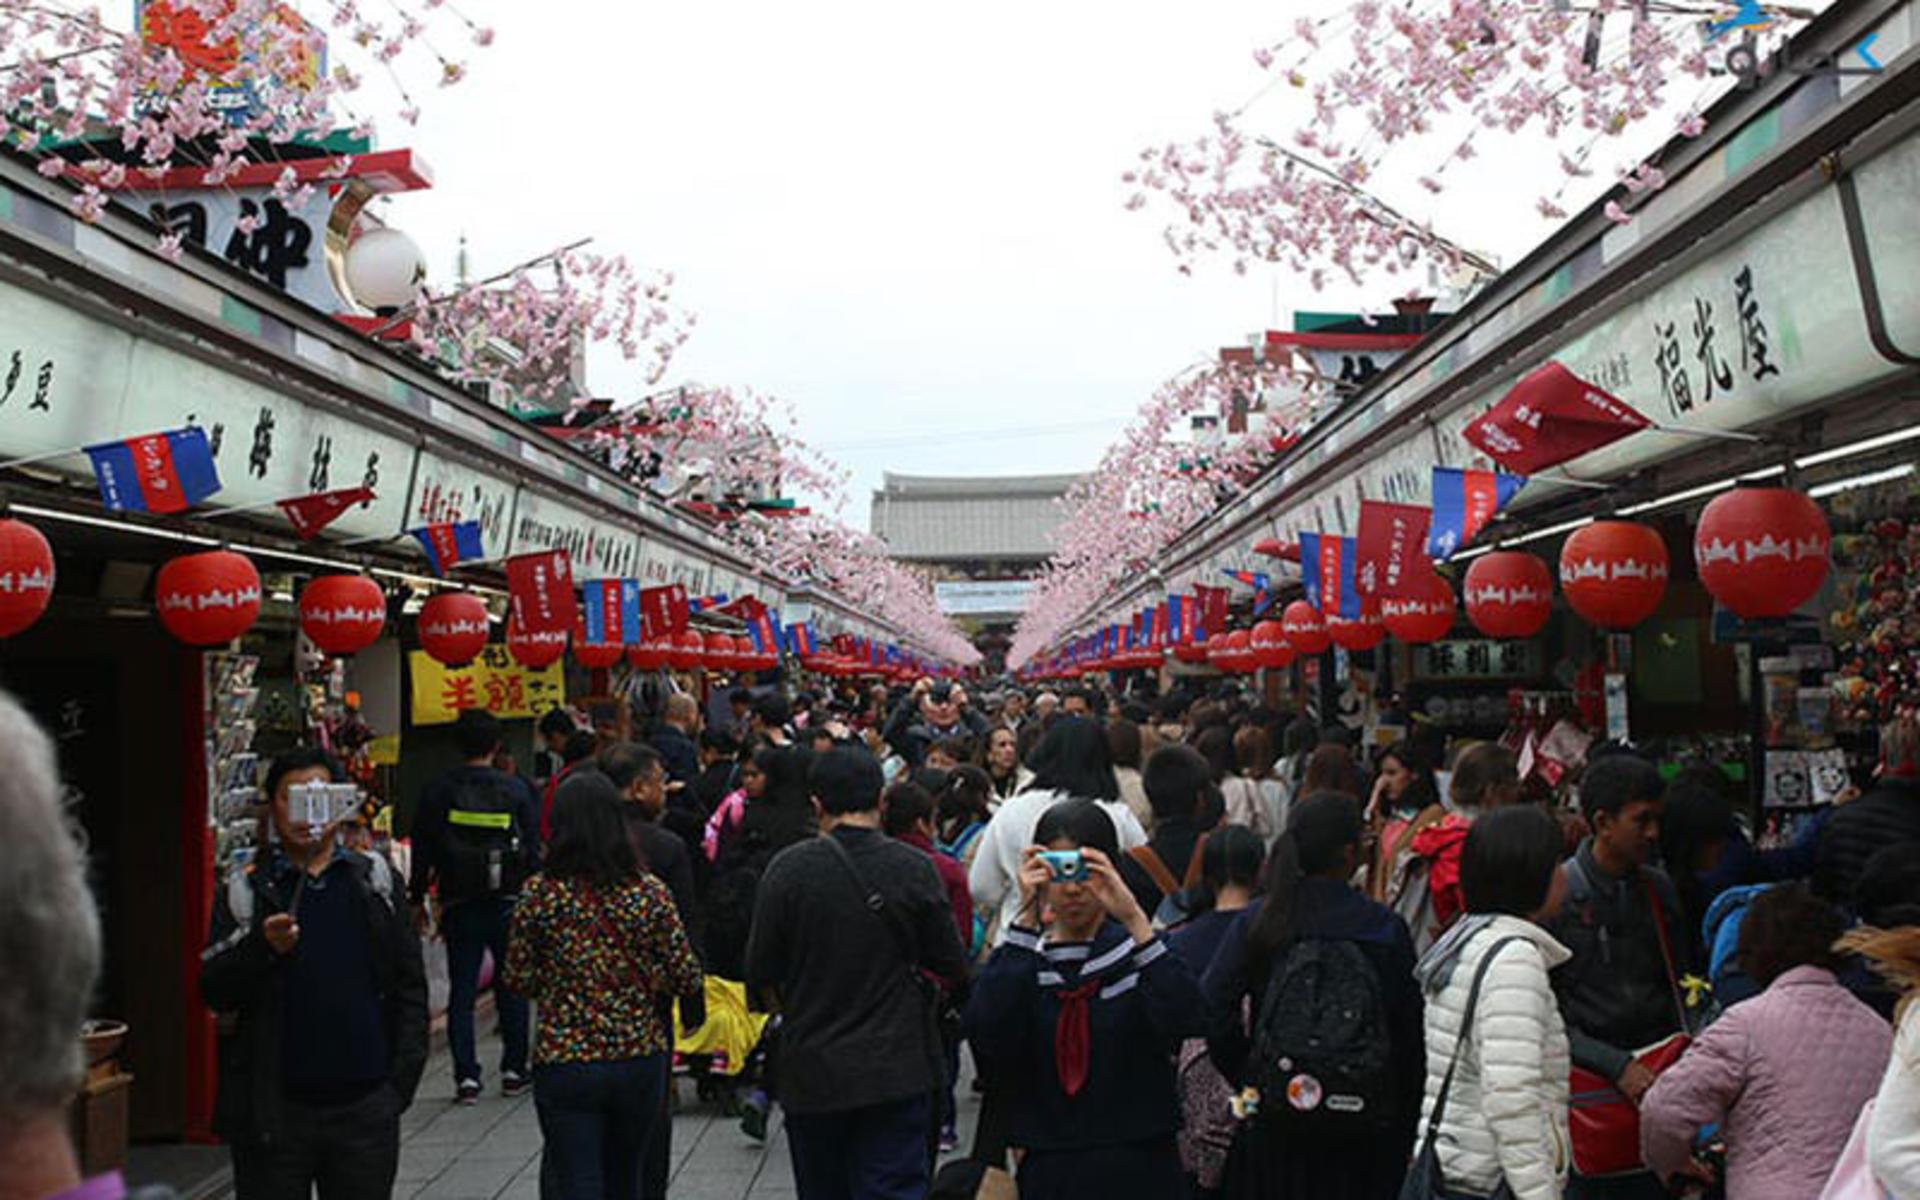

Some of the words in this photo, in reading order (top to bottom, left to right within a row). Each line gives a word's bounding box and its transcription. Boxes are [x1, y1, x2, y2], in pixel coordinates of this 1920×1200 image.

[1654, 265, 1779, 418] 福光屋
[441, 672, 526, 712] 半額
